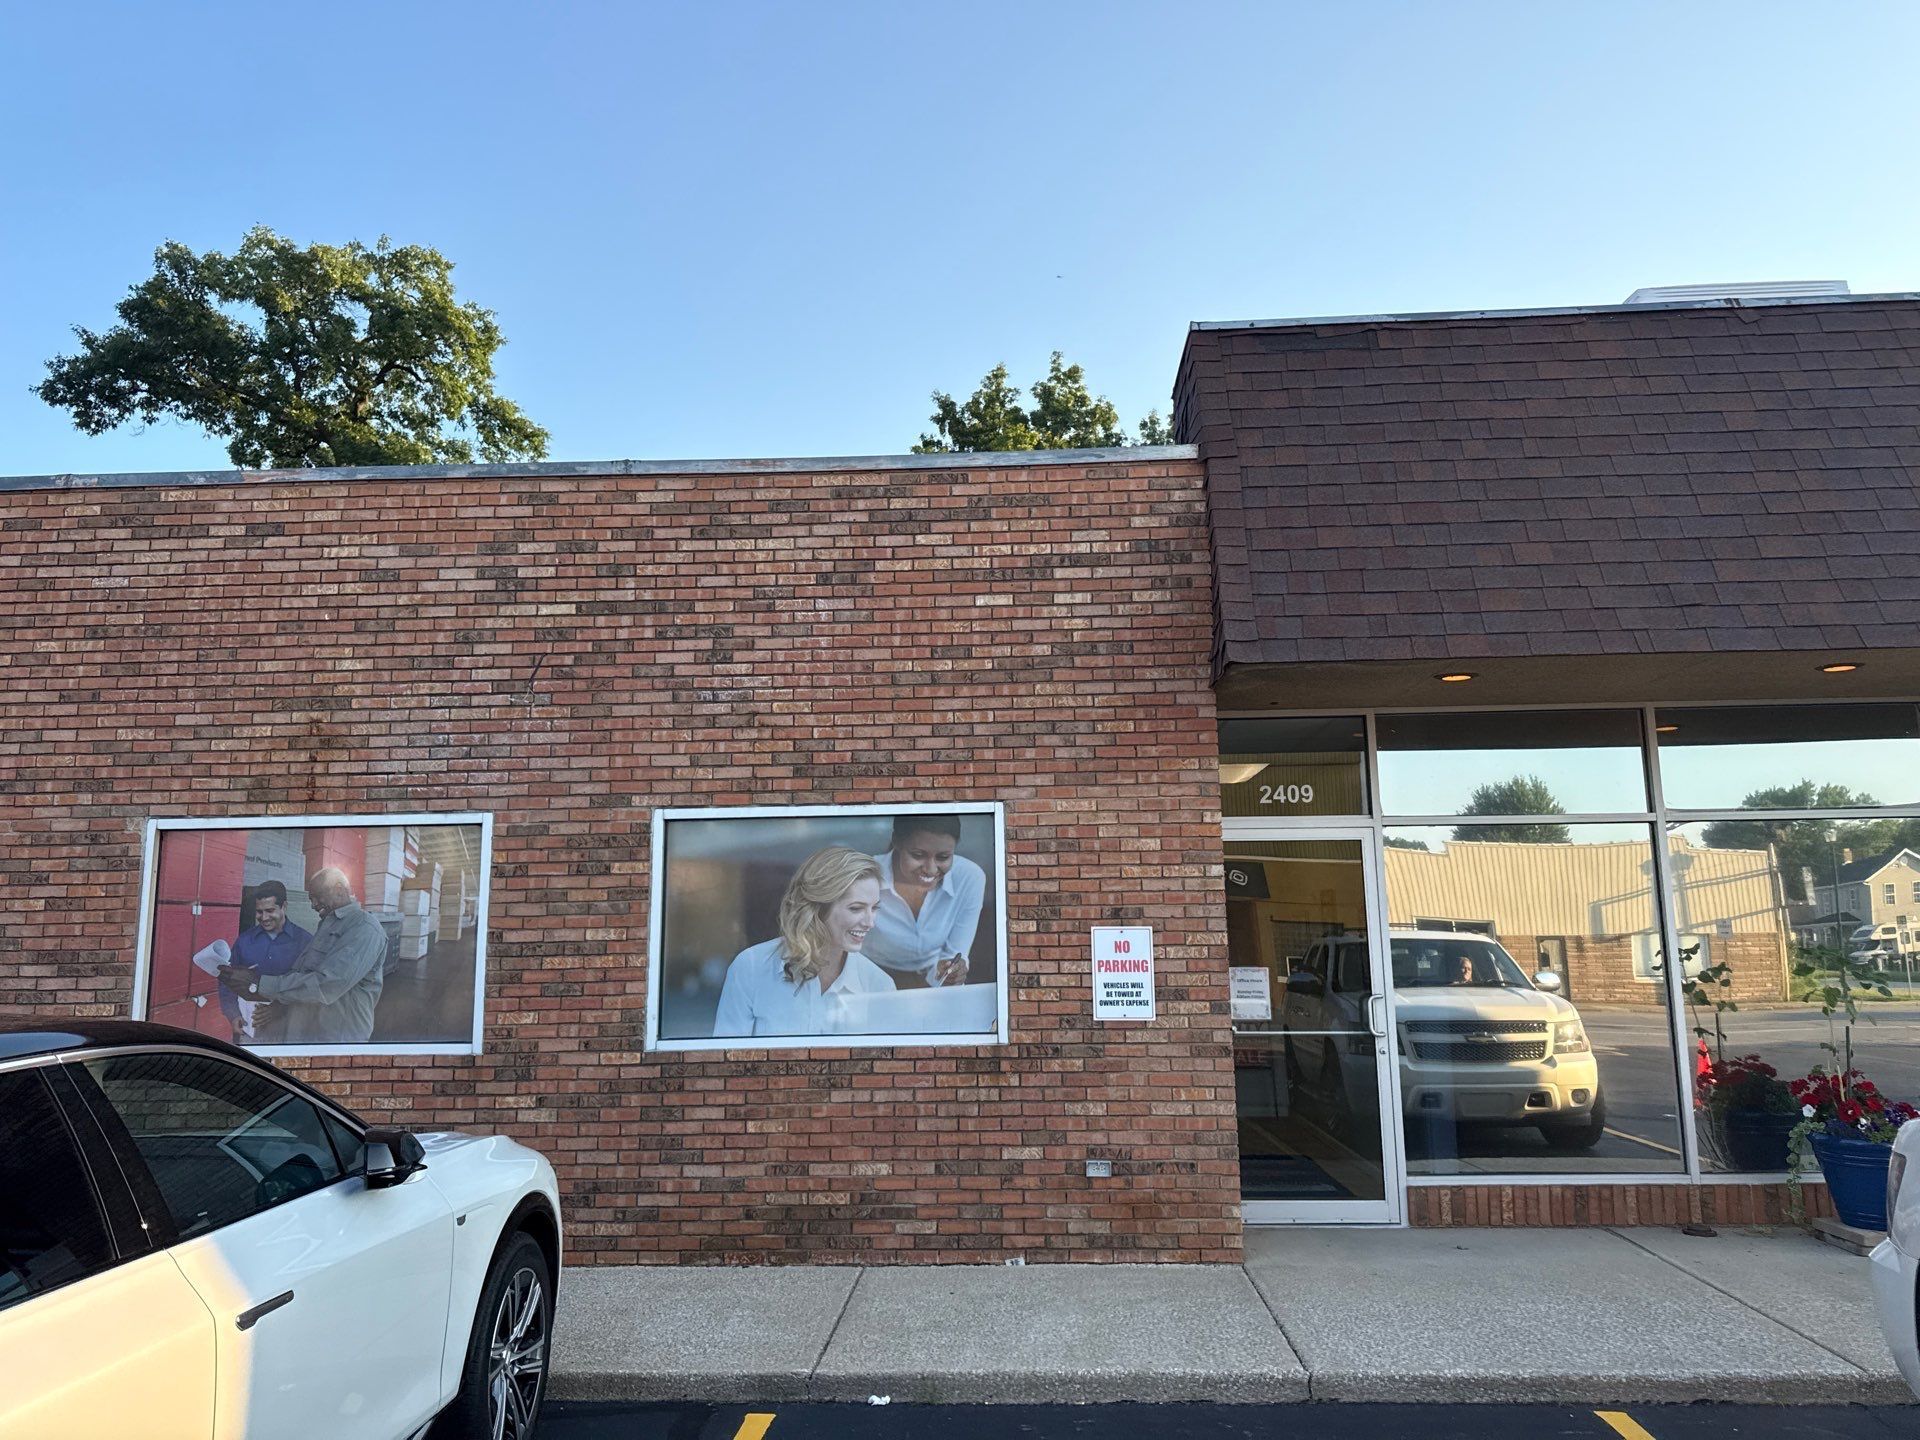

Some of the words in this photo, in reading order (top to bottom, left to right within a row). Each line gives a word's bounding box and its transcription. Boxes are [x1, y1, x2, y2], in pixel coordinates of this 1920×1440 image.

[1260, 784, 1313, 804] 2409
[256, 855, 282, 868] Products
[1114, 940, 1130, 954] NO
[1097, 959, 1149, 973] PARKING
